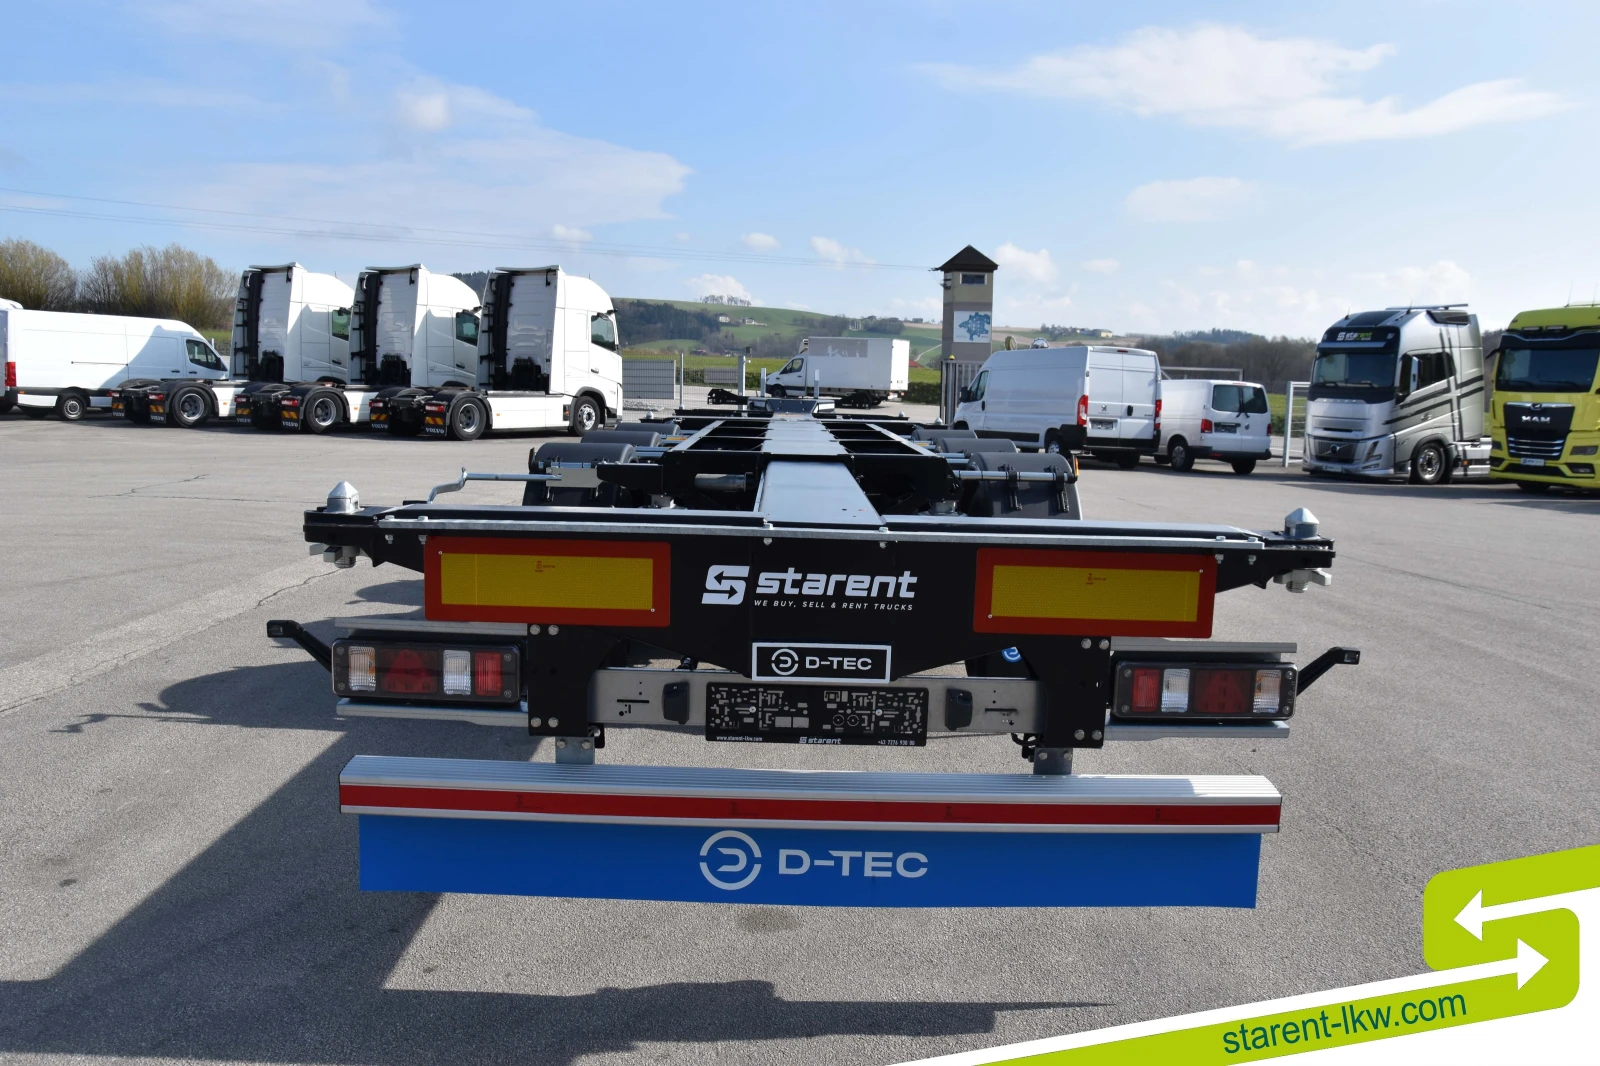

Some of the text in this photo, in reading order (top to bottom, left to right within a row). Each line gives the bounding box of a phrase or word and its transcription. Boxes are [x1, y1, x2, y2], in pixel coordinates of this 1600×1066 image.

[1521, 415, 1551, 423] MAN
[756, 567, 918, 599] starent
[773, 600, 797, 608] BUY,
[842, 602, 868, 610] RENT
[874, 603, 913, 611] TRUCKS
[805, 656, 872, 670] D-TEC
[779, 849, 928, 878] D-TEC
